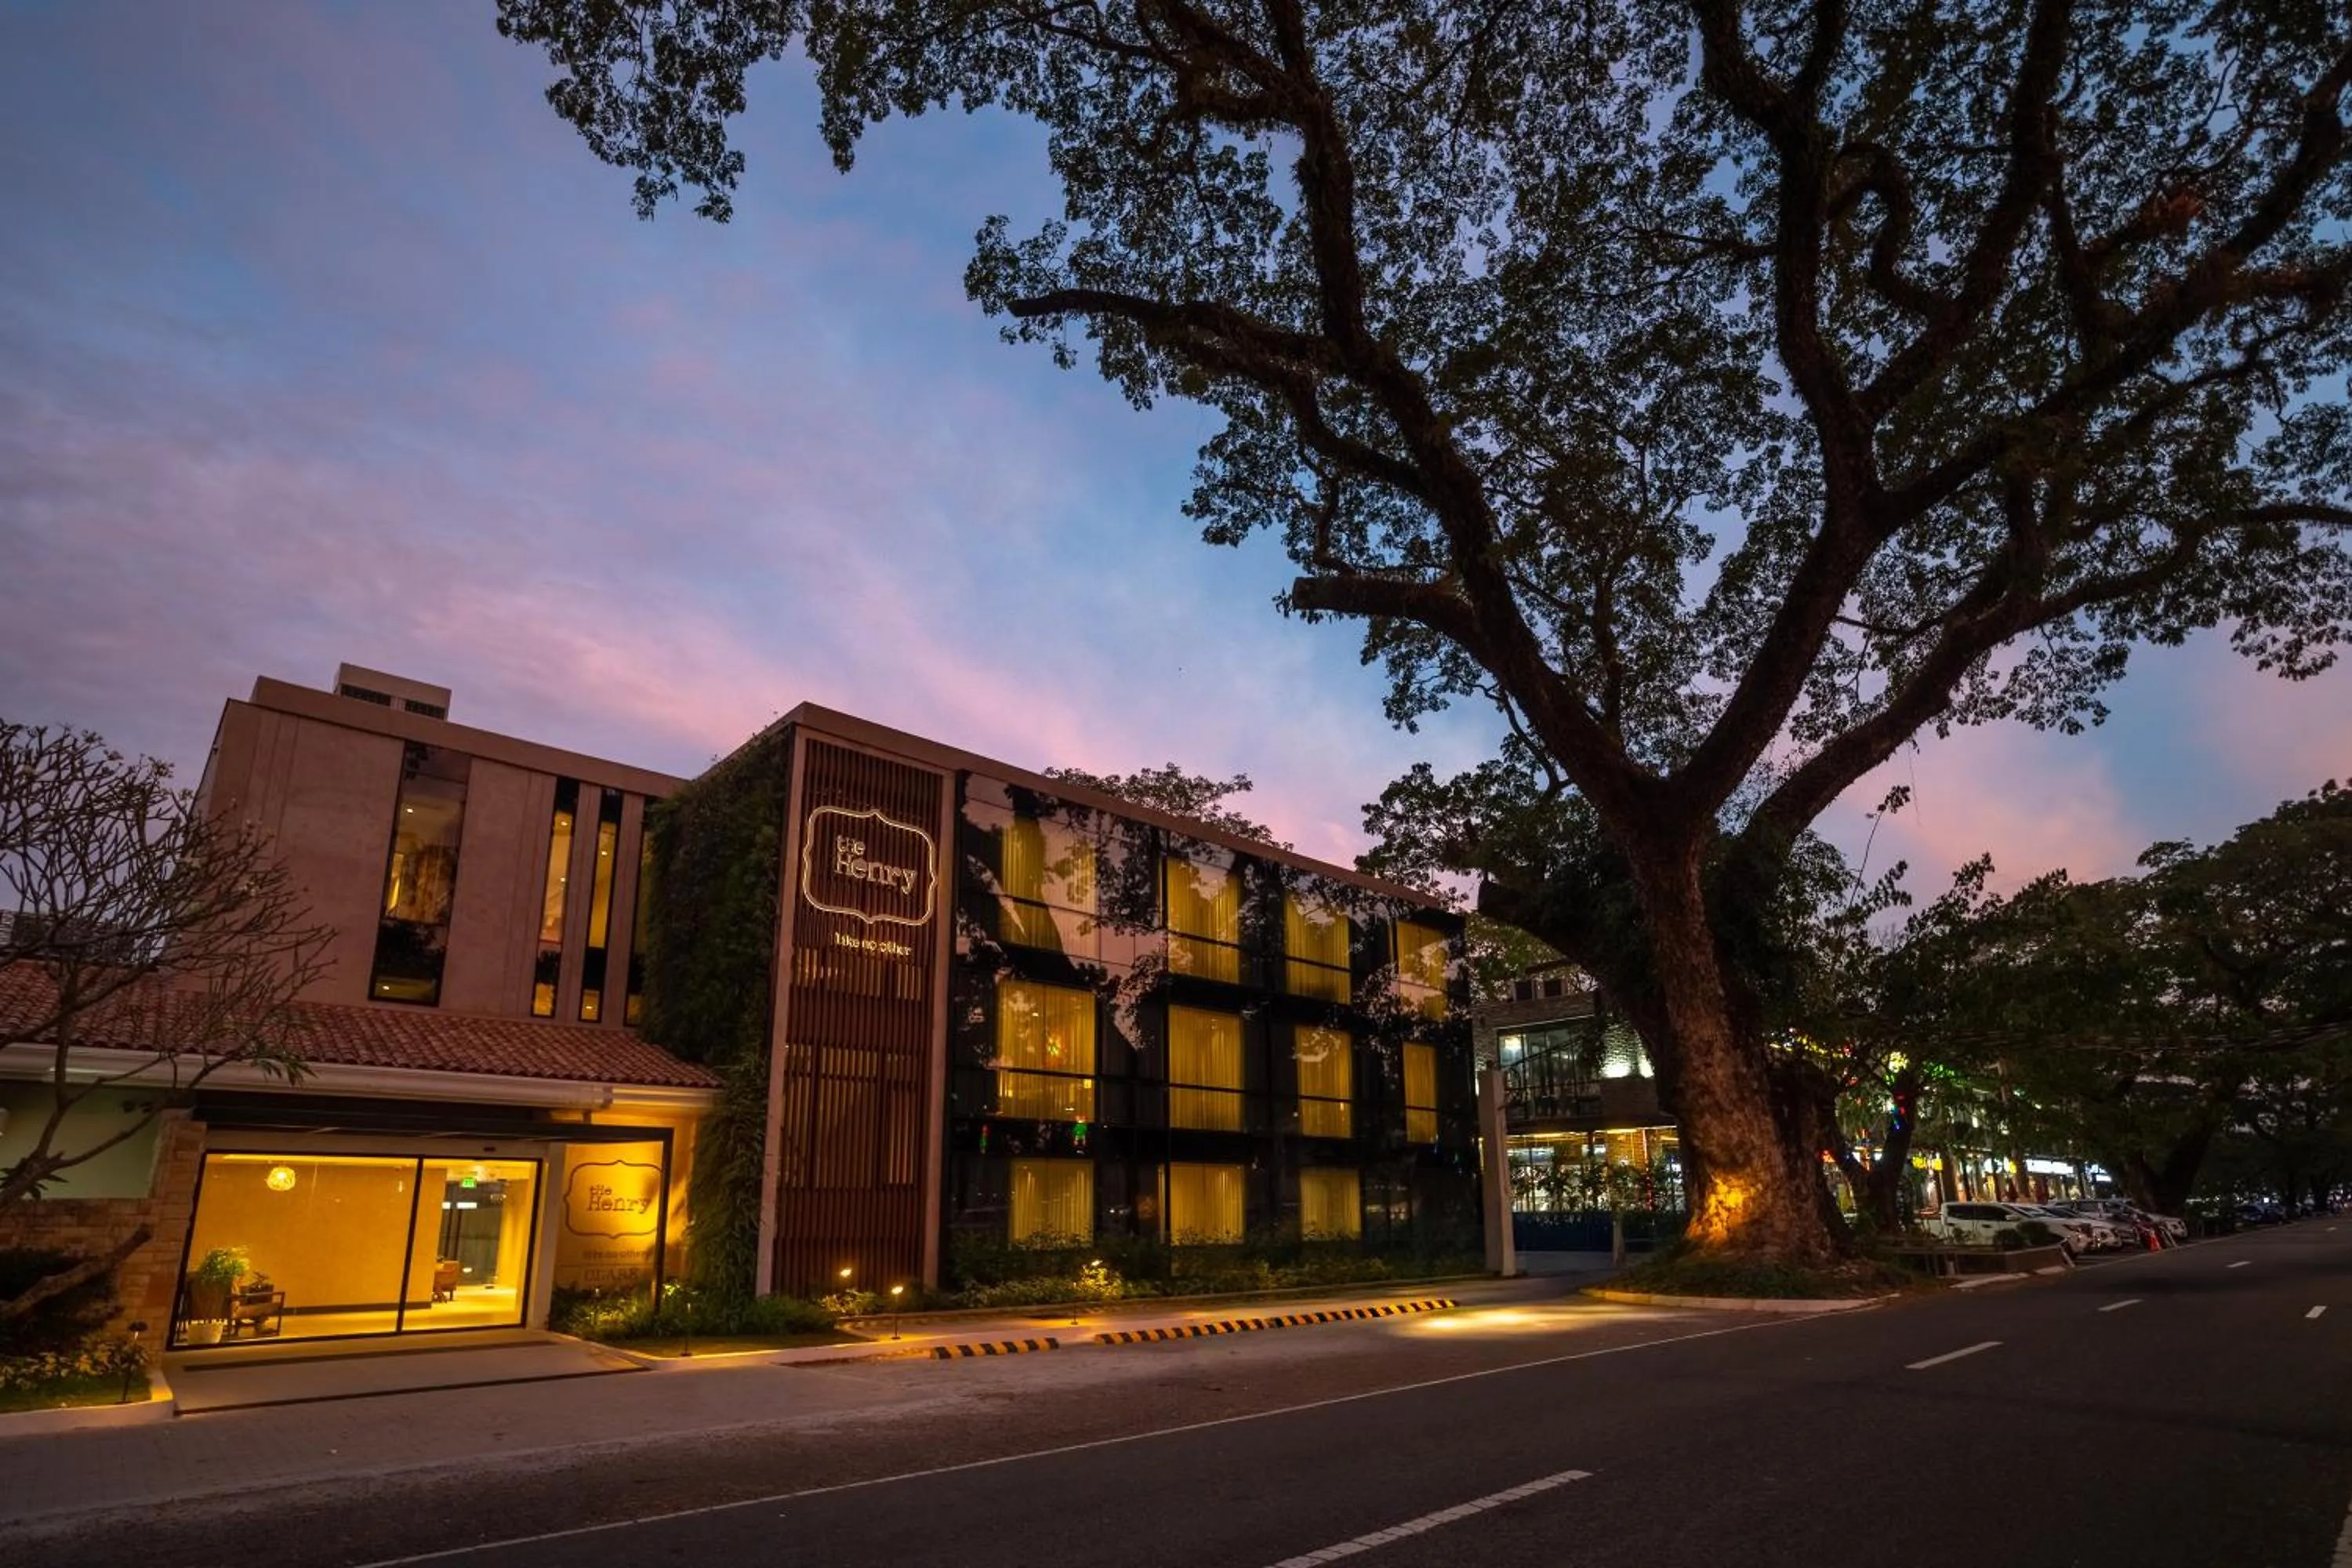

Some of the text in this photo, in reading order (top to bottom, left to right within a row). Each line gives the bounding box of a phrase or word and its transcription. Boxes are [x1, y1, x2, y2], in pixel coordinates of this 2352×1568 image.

[833, 852, 917, 895] Henry
[862, 940, 877, 952] no
[879, 941, 913, 956] other
[587, 1196, 652, 1214] Henry
